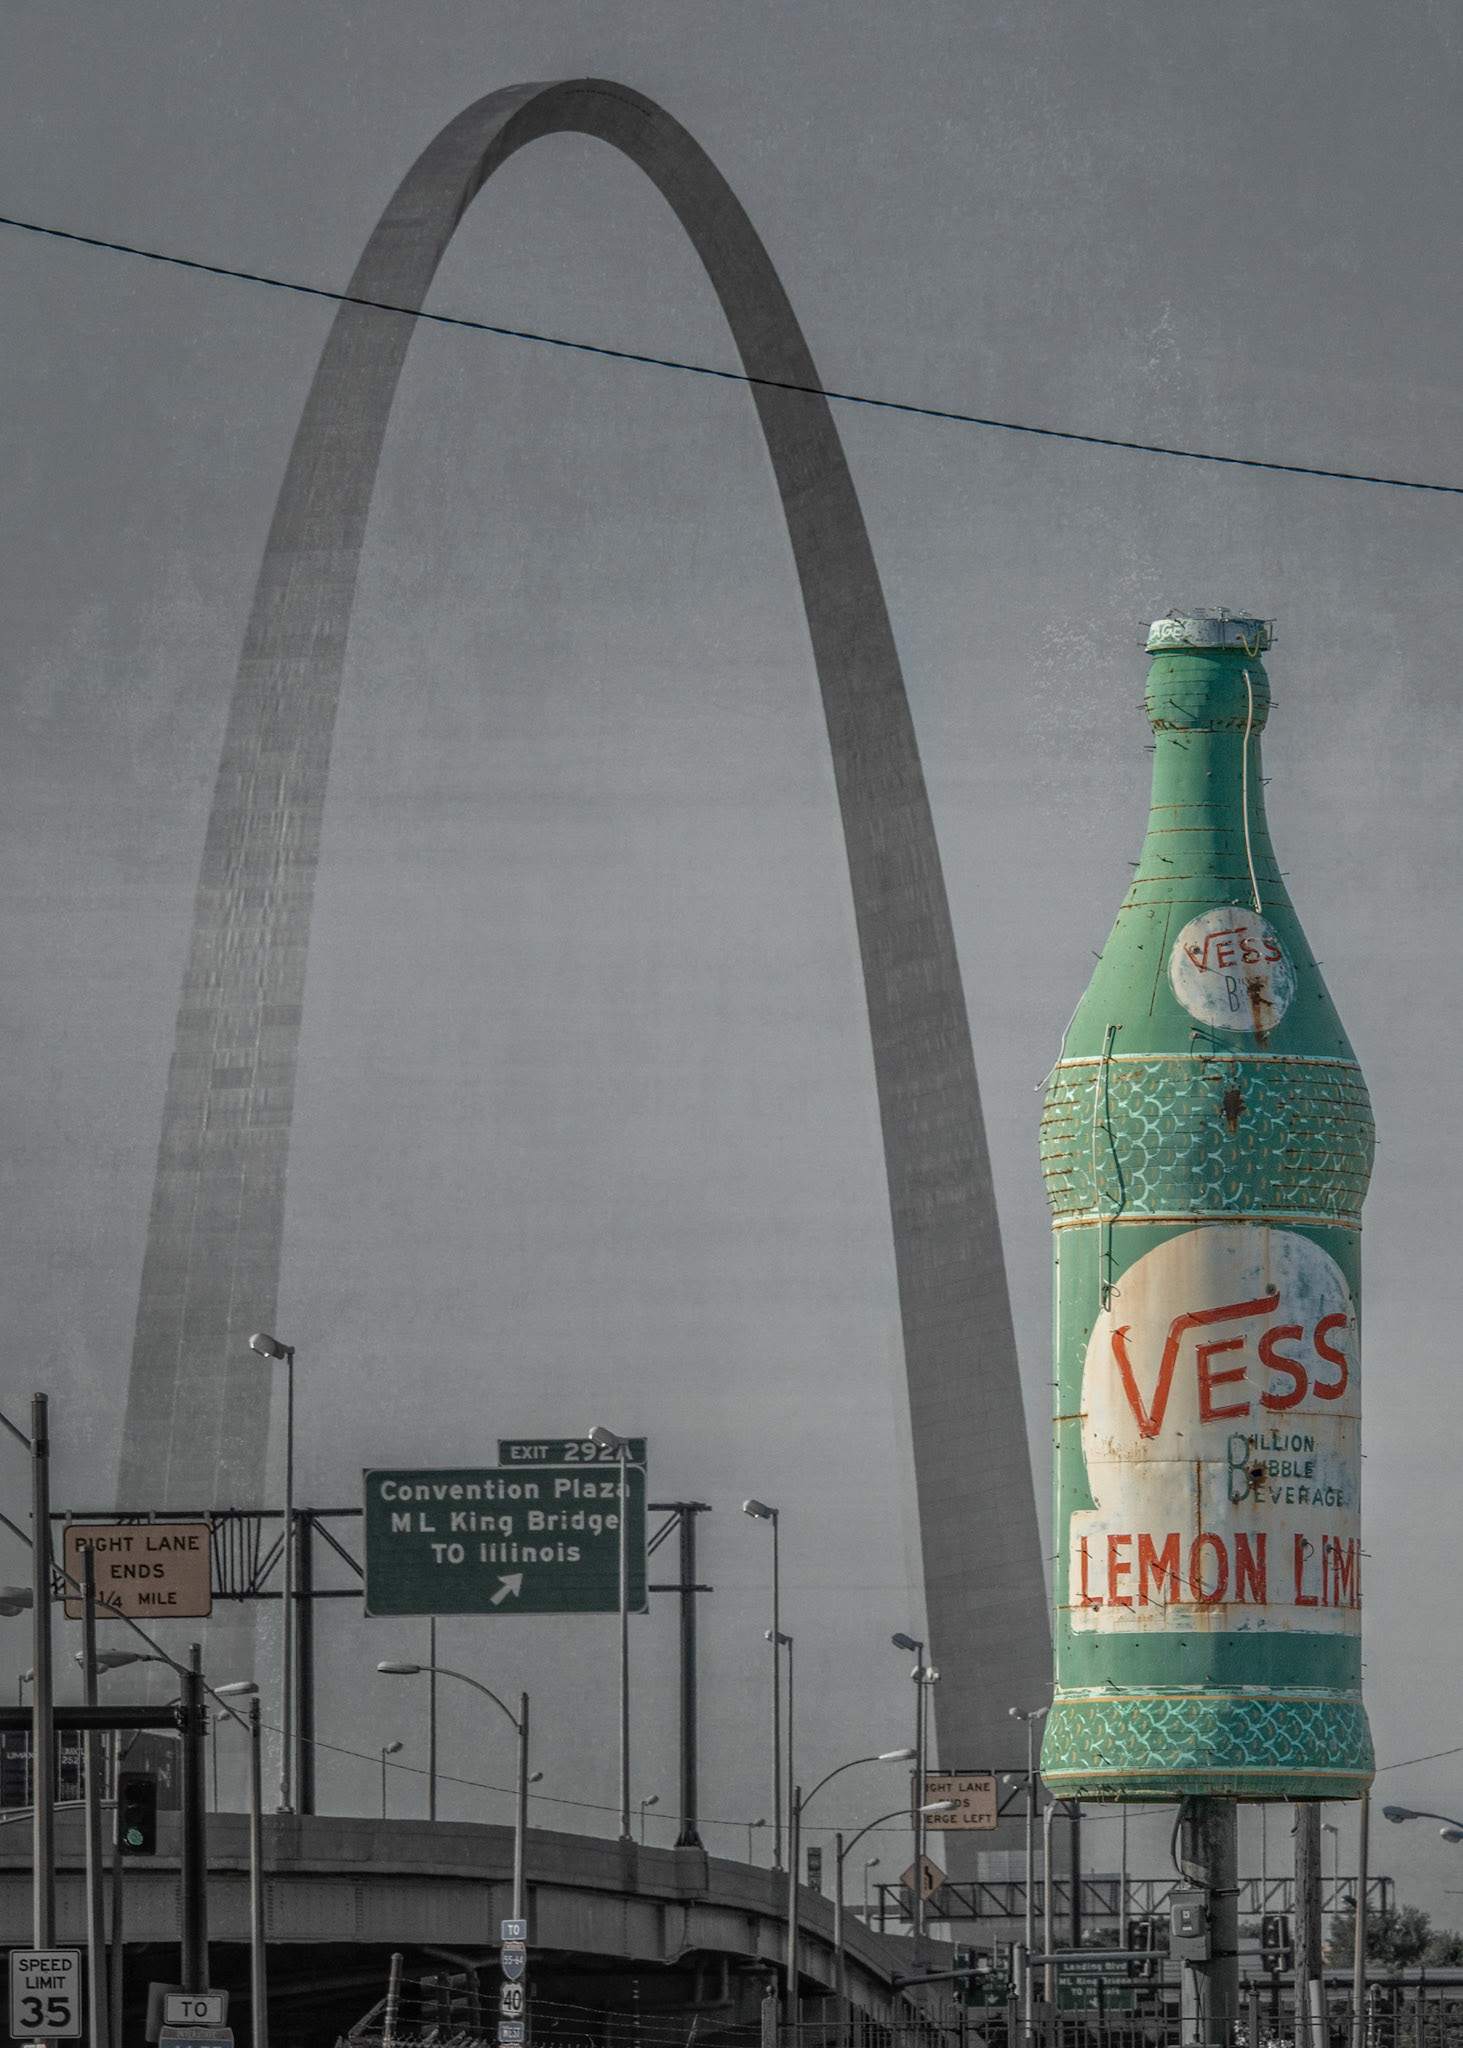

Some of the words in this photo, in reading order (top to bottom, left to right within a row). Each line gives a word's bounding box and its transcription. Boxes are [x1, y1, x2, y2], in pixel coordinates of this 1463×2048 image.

[1183, 926, 1281, 973] VESS
[1111, 1291, 1349, 1439] VESS
[510, 1445, 549, 1459] EXIT
[564, 1442, 633, 1461] 292A
[380, 1480, 540, 1500] Convention
[554, 1478, 630, 1498] Plaza
[450, 1511, 513, 1537] King
[527, 1510, 619, 1535] Bridge
[147, 1536, 200, 1551] LANE
[431, 1544, 465, 1563] TO
[480, 1542, 581, 1562] Illinois
[111, 1564, 165, 1578] ENDS
[1080, 1532, 1268, 1607] LEMON
[138, 1592, 177, 1605] MILE
[959, 1783, 991, 1792] LANE
[927, 1815, 957, 1824] ERGE
[964, 1815, 992, 1823] LEFT
[507, 1925, 520, 1935] TO
[18, 1958, 72, 1972] SPEED
[25, 1976, 66, 1989] LIMIT
[504, 1990, 521, 2010] 40
[19, 1995, 72, 2028] 35
[181, 2001, 207, 2017] TO
